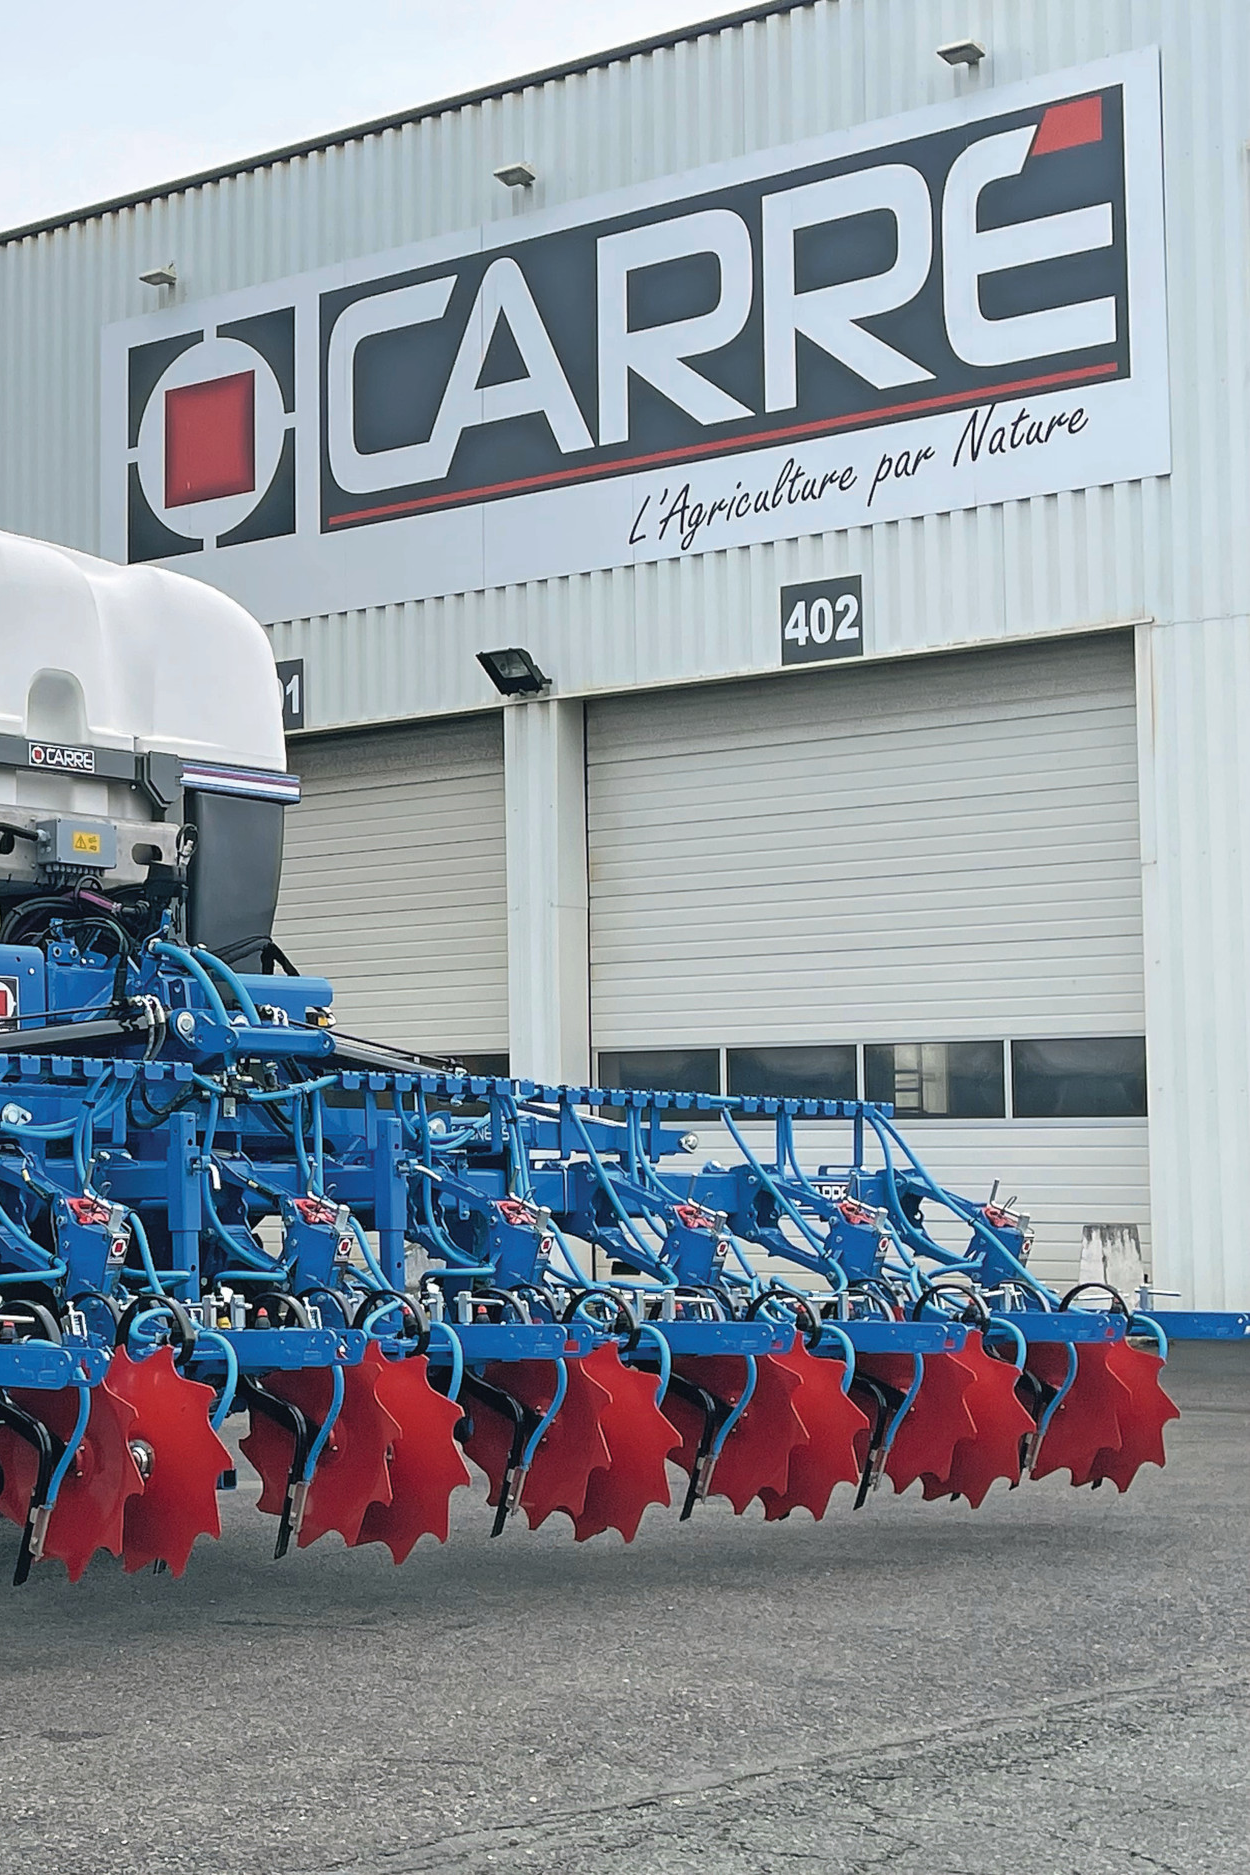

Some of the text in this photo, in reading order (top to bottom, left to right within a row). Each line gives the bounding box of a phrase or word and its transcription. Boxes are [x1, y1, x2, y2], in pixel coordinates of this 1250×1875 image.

[628, 403, 1089, 550] L'Agriculture par Nature
[784, 593, 859, 646] 402
